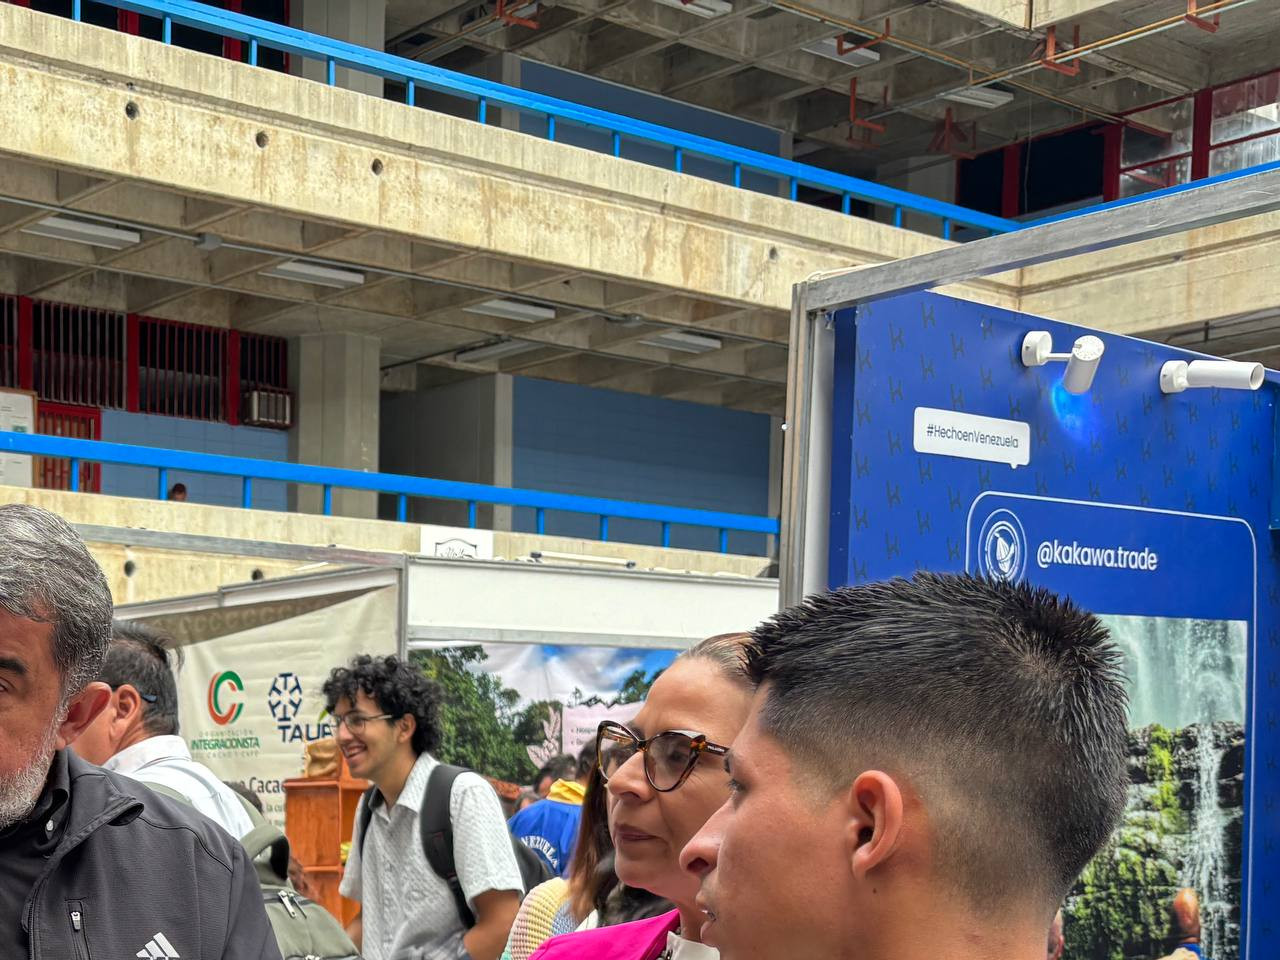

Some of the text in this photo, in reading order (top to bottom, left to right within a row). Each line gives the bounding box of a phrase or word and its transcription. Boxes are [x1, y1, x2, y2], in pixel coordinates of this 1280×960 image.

[926, 423, 1019, 449] #HechoenVenezuela
[1037, 540, 1158, 571] @kakawa.trade
[191, 737, 261, 750] INTEGRACIONISTA
